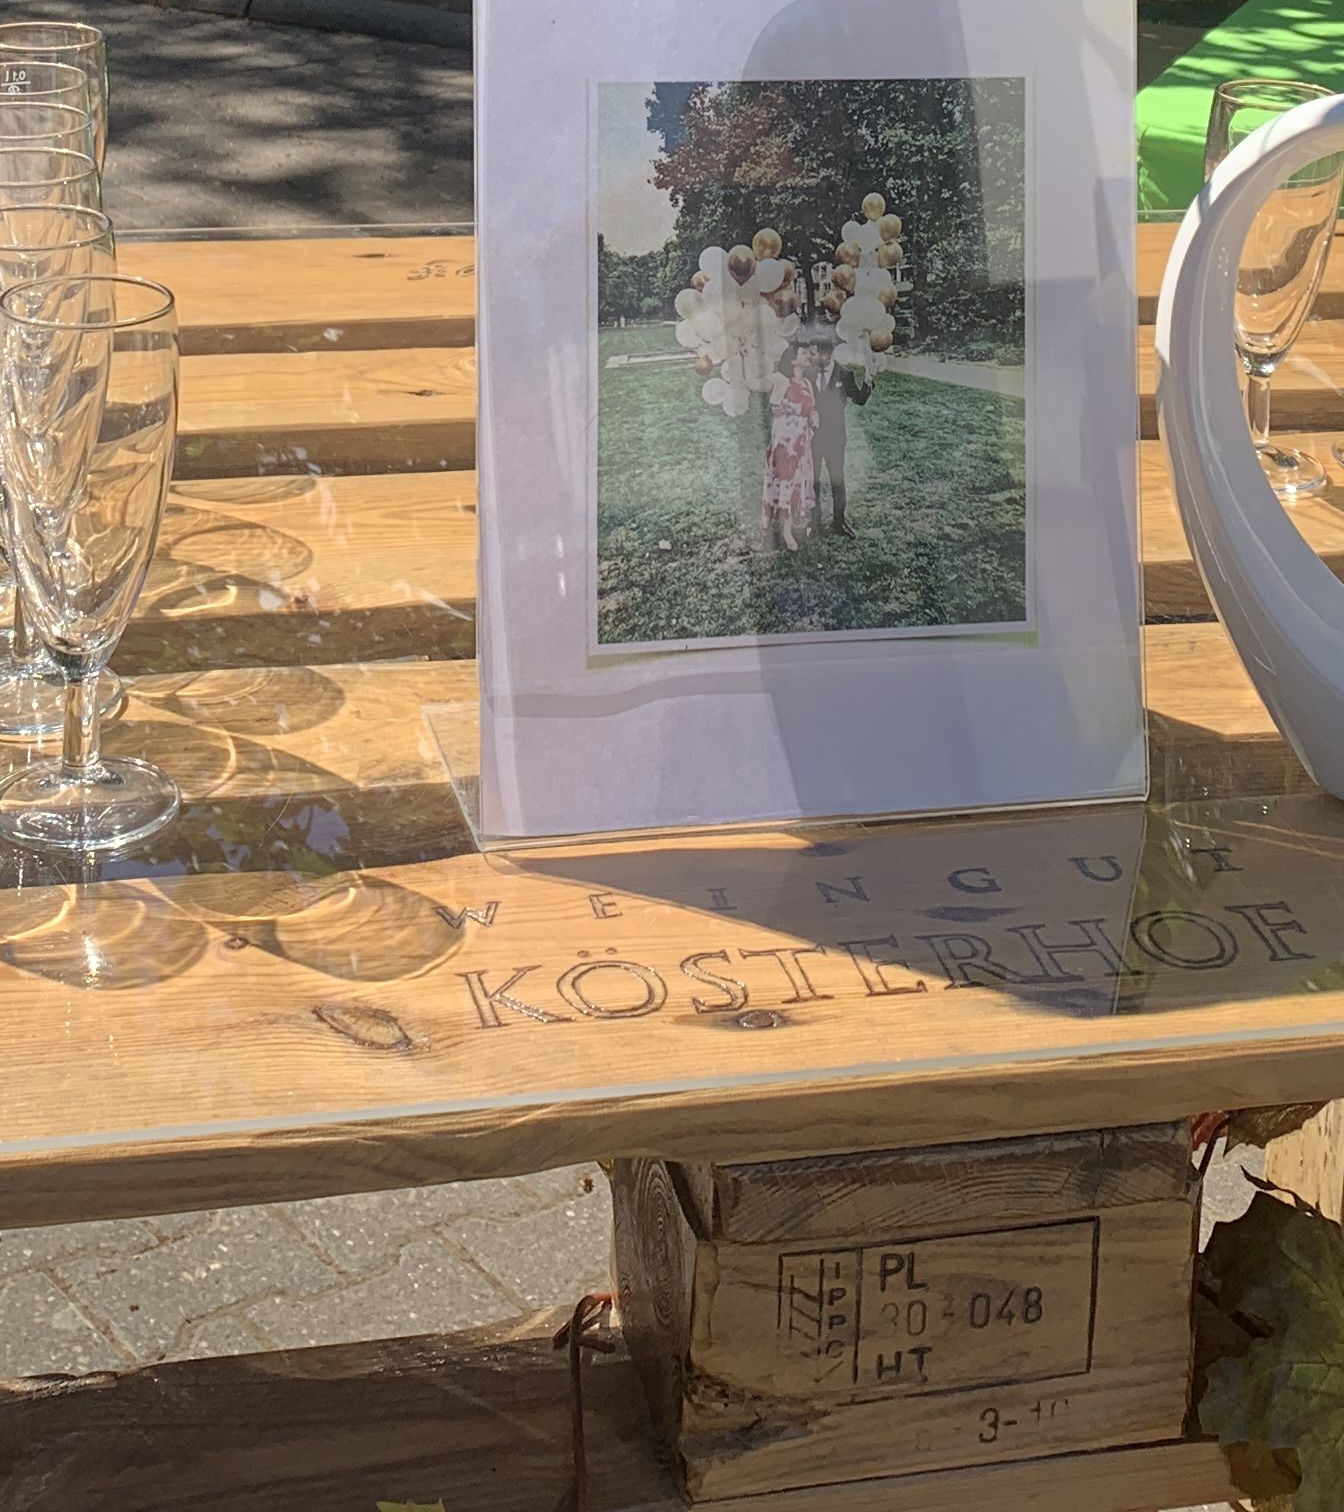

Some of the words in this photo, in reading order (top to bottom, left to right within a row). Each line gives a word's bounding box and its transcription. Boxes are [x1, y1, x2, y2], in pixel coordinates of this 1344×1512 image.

[431, 845, 1244, 930] WEINGUT
[455, 900, 1316, 1030] KÖSTERHOF
[879, 1252, 929, 1293] PL
[875, 1345, 934, 1383] HT
